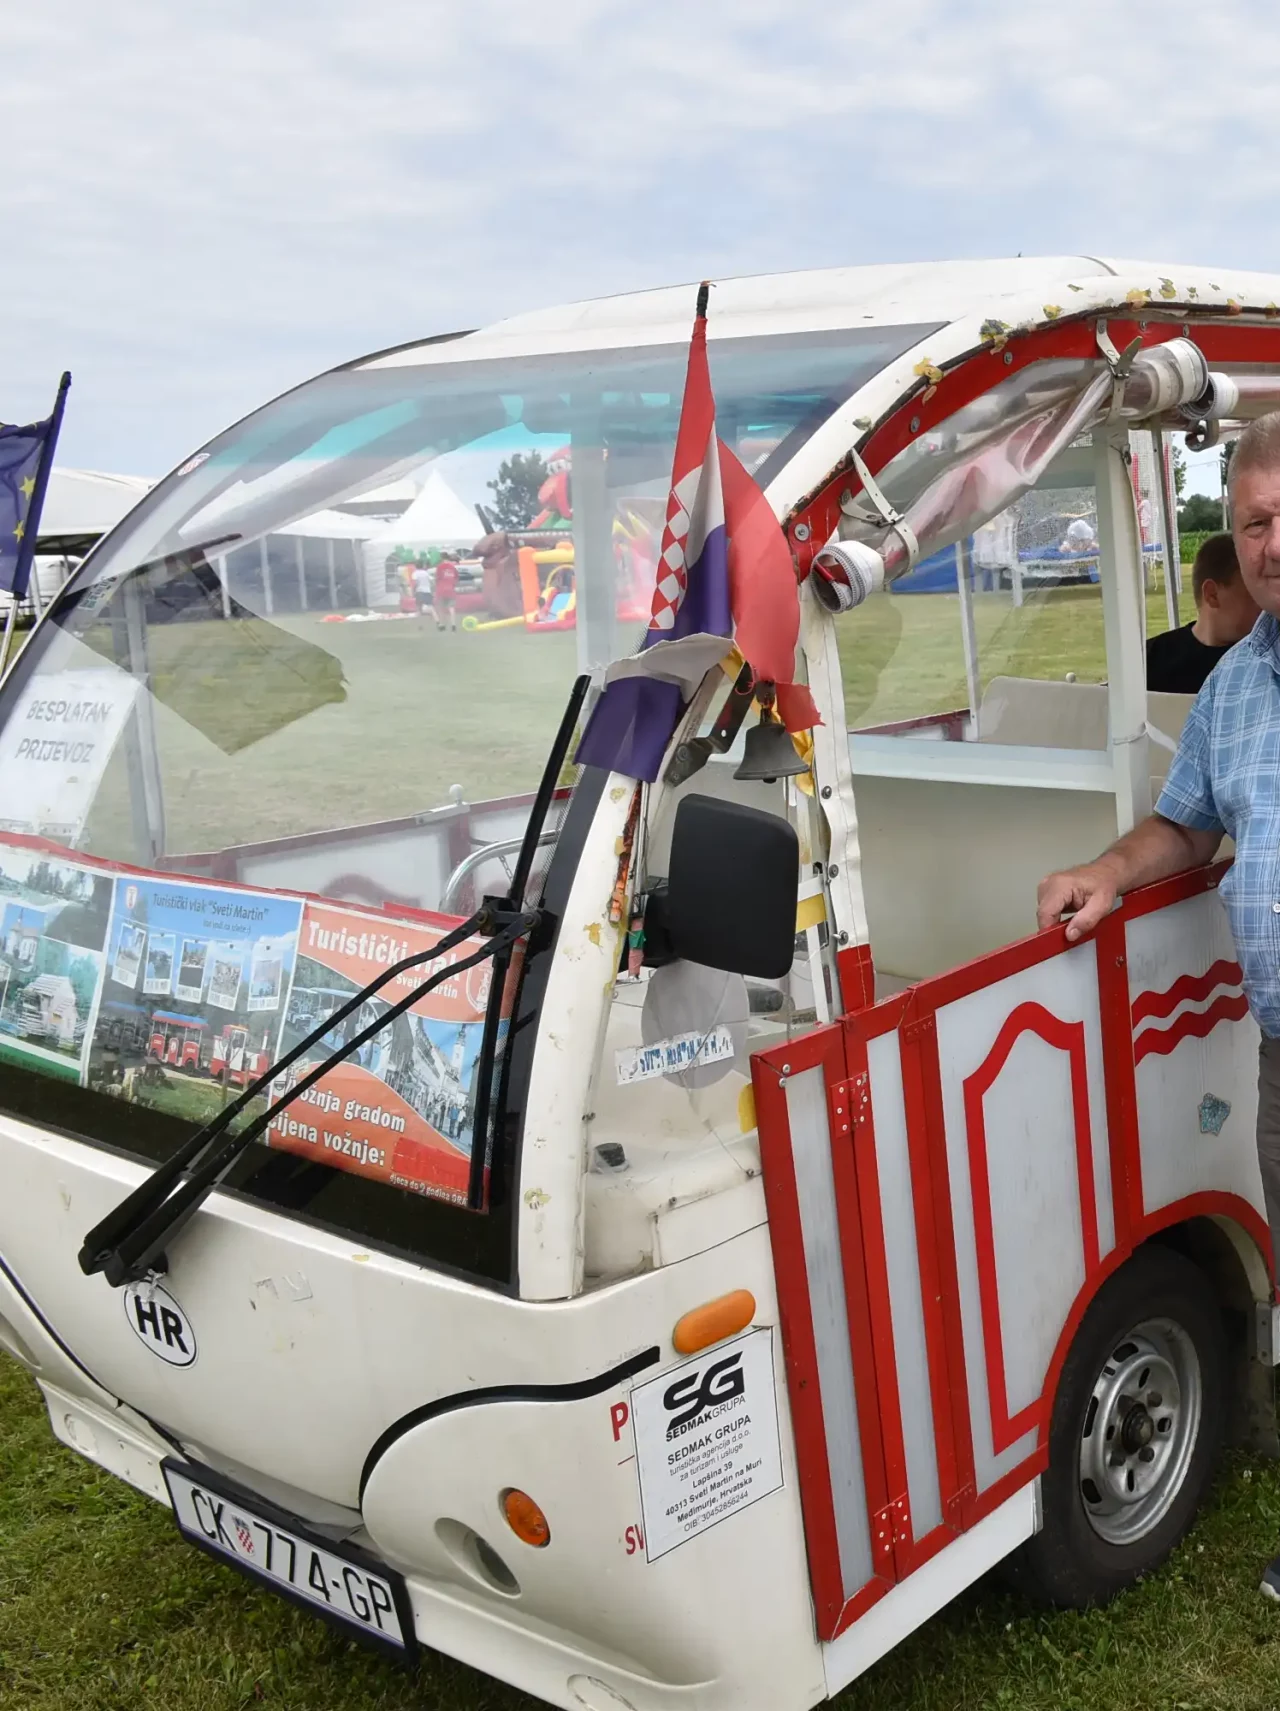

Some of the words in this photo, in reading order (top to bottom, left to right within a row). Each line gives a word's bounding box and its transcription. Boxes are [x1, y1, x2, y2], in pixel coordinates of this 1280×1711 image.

[26, 699, 113, 722] BESPLATAN
[14, 738, 95, 763] PRIJEVOZ
[189, 898, 206, 914] vlak
[308, 921, 408, 966] Turistički
[395, 972, 421, 989] Sveti
[431, 983, 458, 999] artin
[300, 1084, 341, 1113] ožnja
[344, 1100, 406, 1133] gradom
[324, 1132, 386, 1166] vožnje:
[134, 1294, 190, 1356] HR
[663, 1350, 745, 1432] SG
[665, 1395, 746, 1442] SEDMAKGRUPA
[667, 1433, 713, 1466] SEDMAK
[715, 1414, 752, 1441] GRUPA
[669, 1453, 701, 1477] turistička
[701, 1439, 731, 1460] agencija
[731, 1428, 751, 1443] d.o.o.
[680, 1472, 689, 1482] za
[690, 1459, 716, 1476] turizam
[720, 1443, 744, 1460] usluge
[692, 1467, 722, 1489] Lapšina
[724, 1461, 733, 1471] 39
[665, 1498, 688, 1517] 40313
[689, 1486, 708, 1504] Sveti
[710, 1474, 734, 1493] Martin
[735, 1468, 744, 1477] na
[745, 1458, 762, 1473] Muri
[720, 1476, 753, 1500] Hrvatska
[252, 1520, 392, 1630] 774-GP
